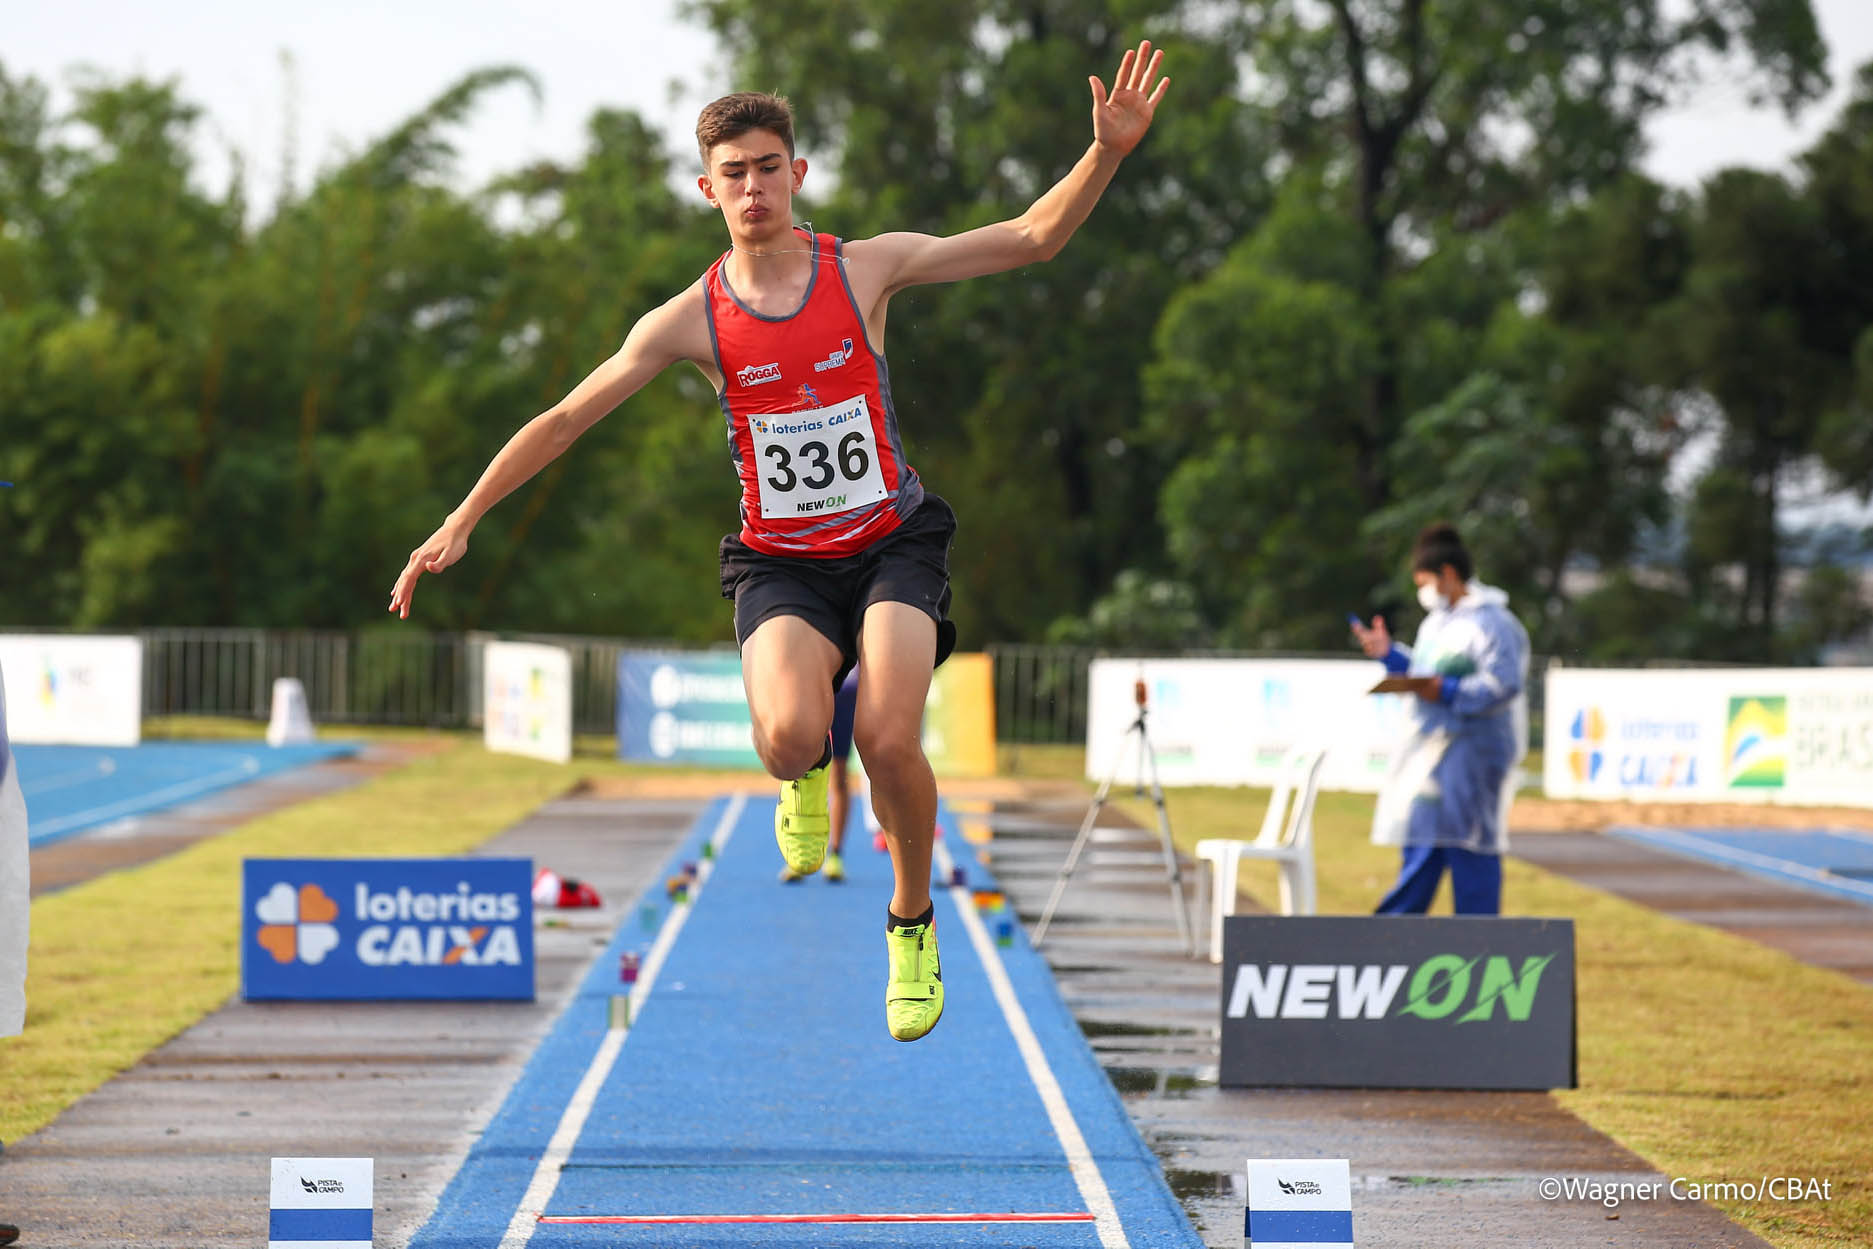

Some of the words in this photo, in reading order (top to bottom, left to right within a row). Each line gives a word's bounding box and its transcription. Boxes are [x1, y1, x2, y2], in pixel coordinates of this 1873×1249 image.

[738, 366, 780, 387] ROGGA
[772, 420, 823, 434] loterias
[828, 407, 862, 427] CAIXA
[764, 431, 869, 492] 336
[354, 881, 520, 921] loterias
[355, 925, 522, 966] CAIXA
